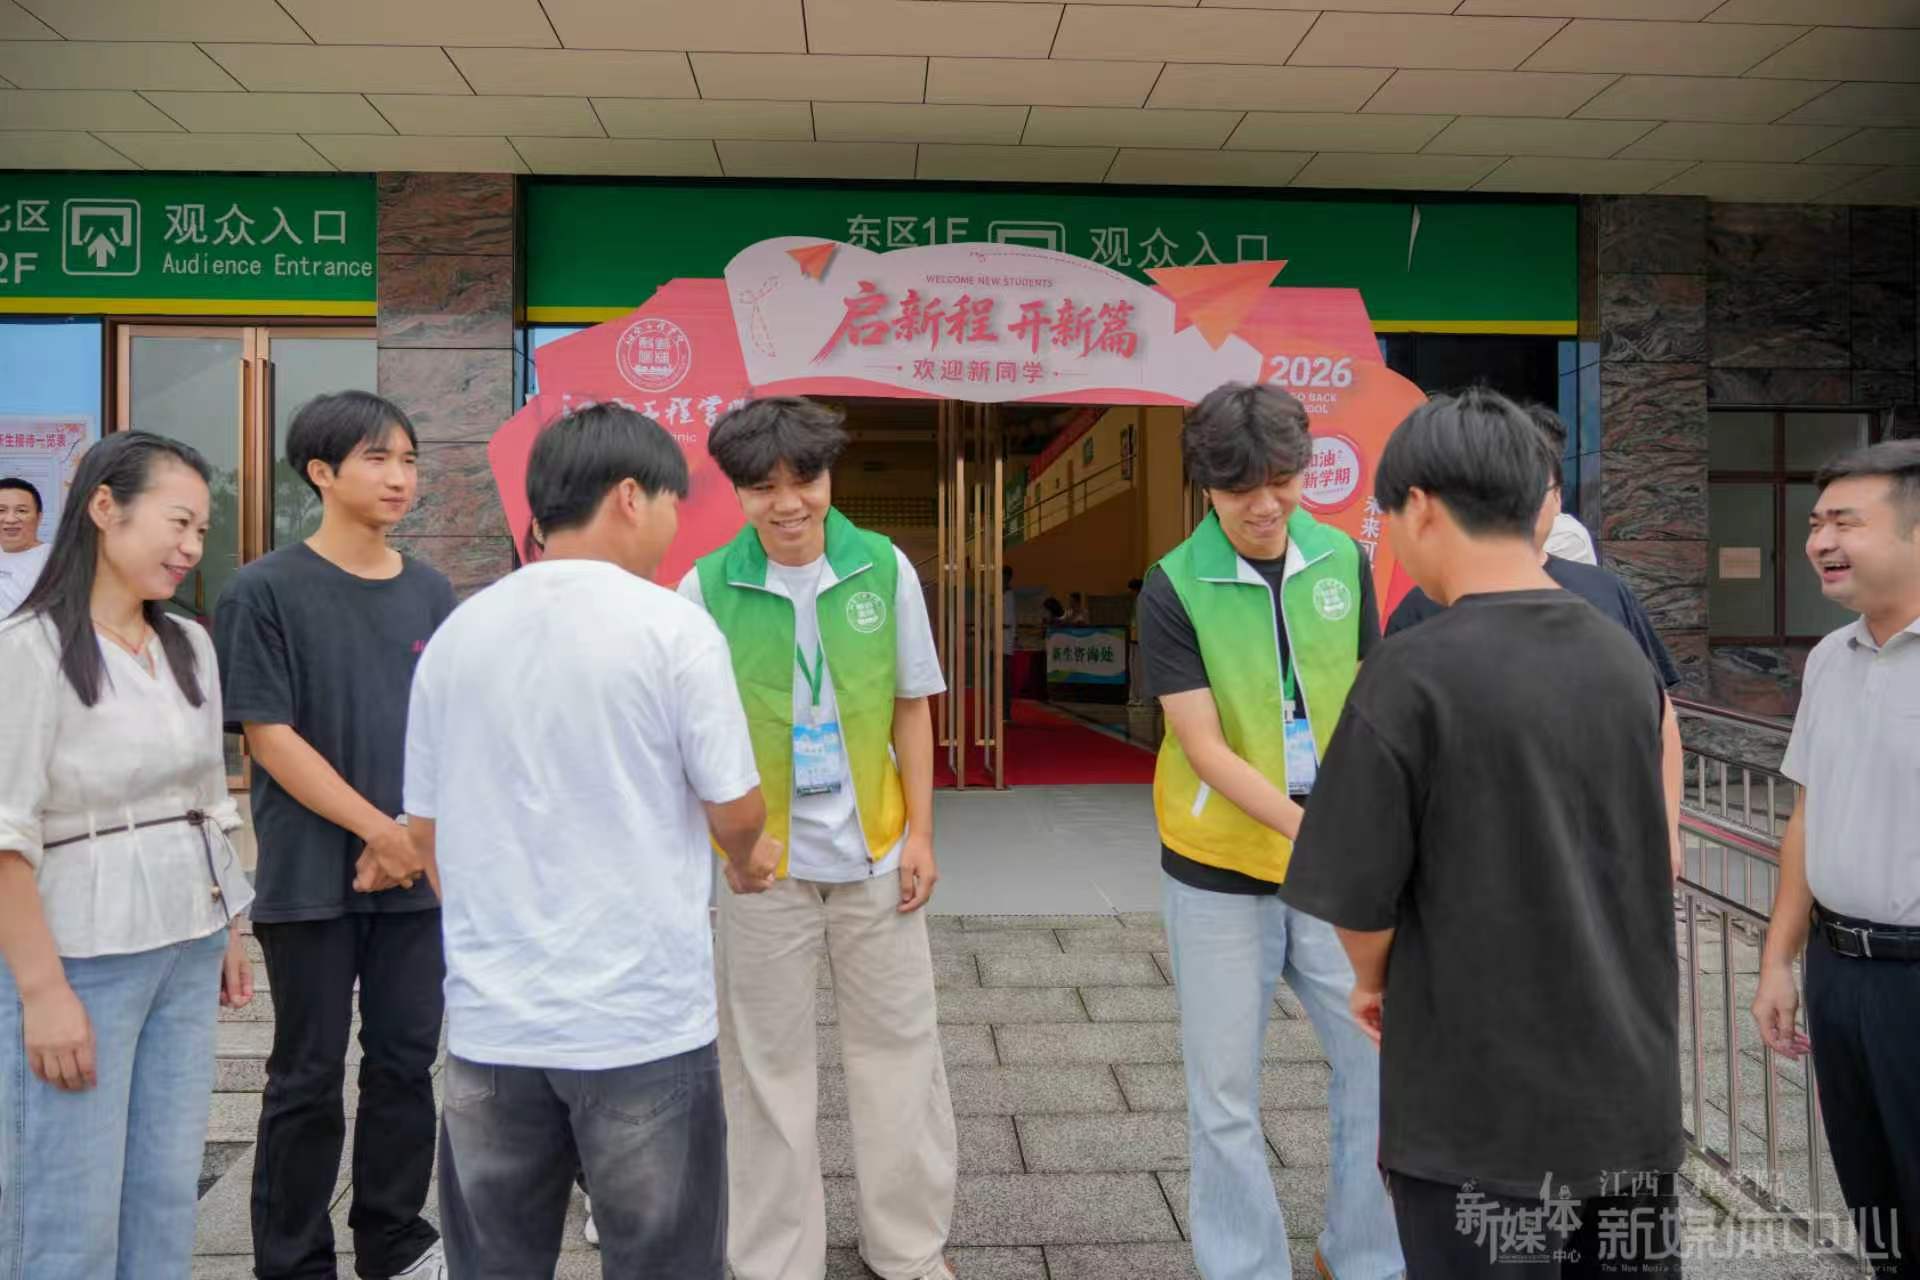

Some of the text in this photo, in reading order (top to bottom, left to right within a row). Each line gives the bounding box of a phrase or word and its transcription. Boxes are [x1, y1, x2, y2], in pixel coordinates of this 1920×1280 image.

[163, 203, 347, 246] 观众入口
[847, 213, 969, 248] 东区1F
[1088, 226, 1268, 268] 观众入口
[162, 252, 373, 277] Audience Entrance
[926, 274, 1053, 288] WELCOME NEW STUDENTS
[808, 279, 1138, 364] 启新程 开新篇
[912, 358, 1044, 384] 欢迎新同学
[1269, 355, 1353, 388] 2026
[1303, 467, 1352, 489] 新学期
